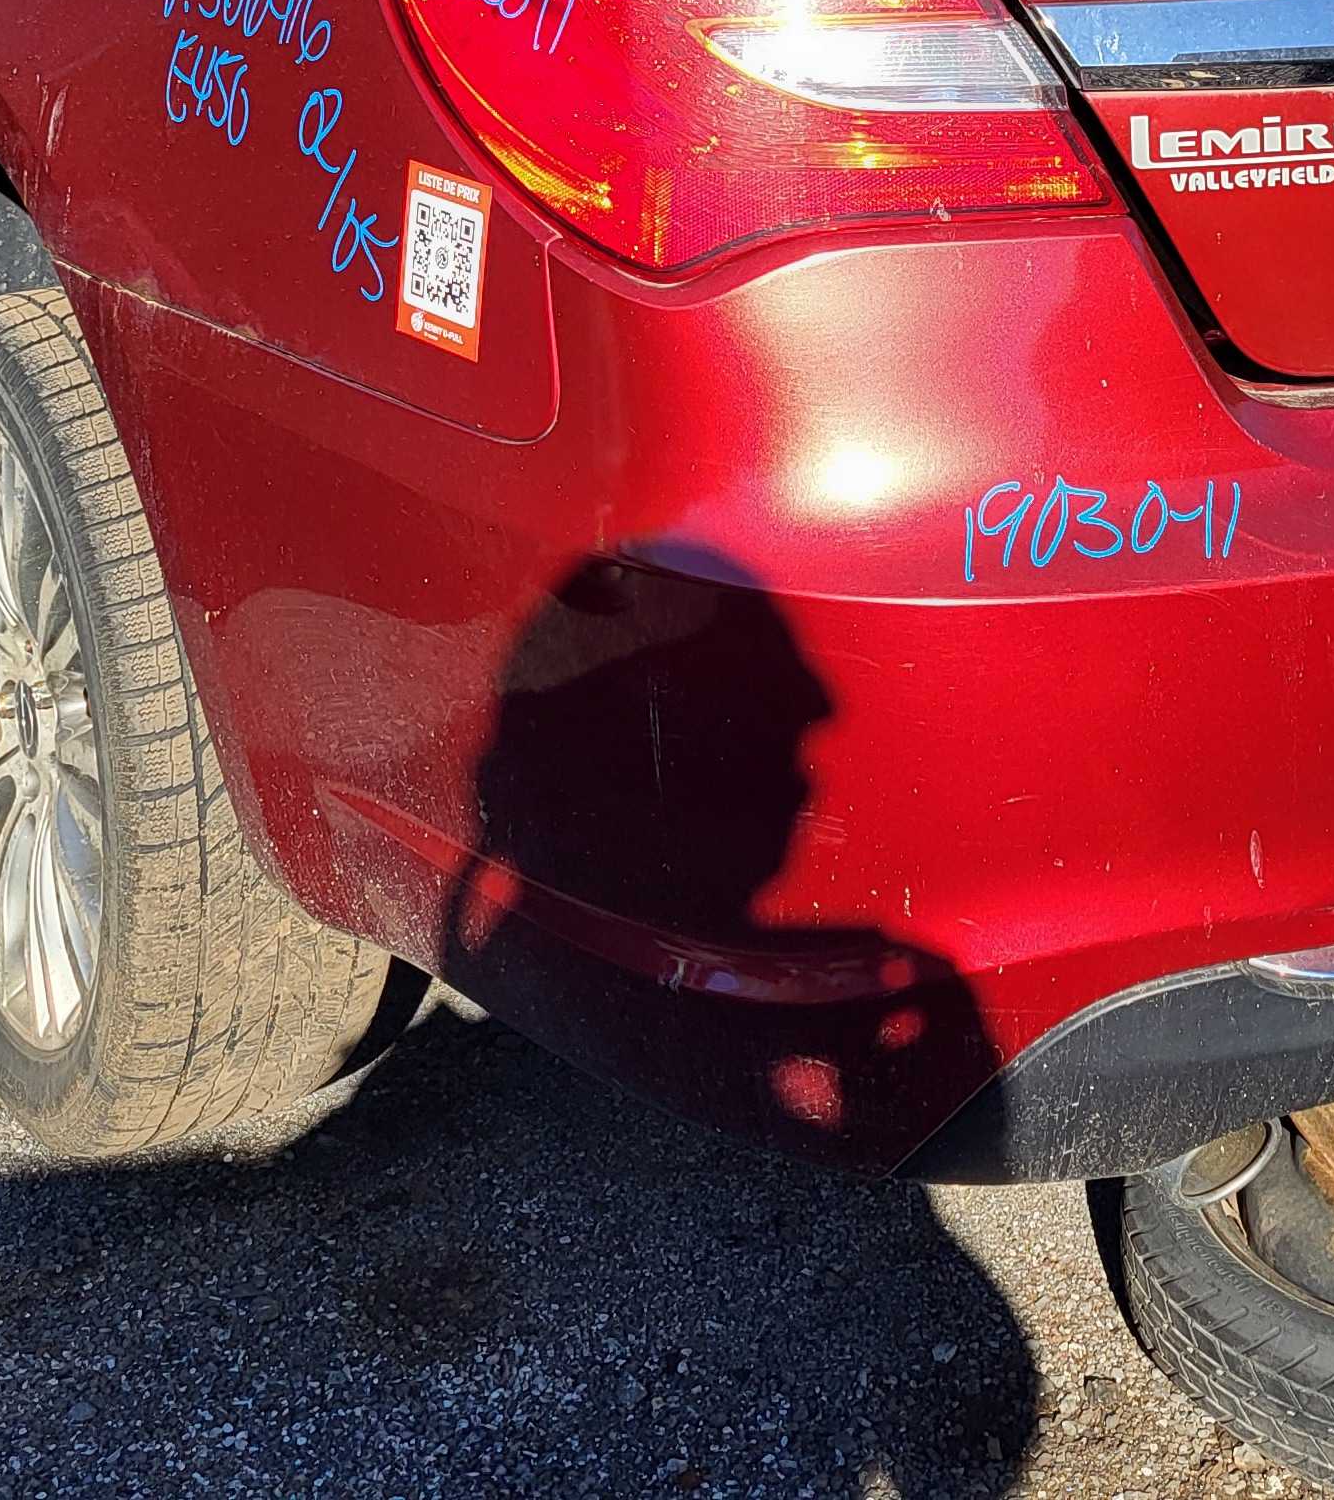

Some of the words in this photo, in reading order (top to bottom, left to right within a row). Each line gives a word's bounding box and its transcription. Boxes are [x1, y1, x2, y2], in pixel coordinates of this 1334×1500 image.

[418, 170, 444, 191] LISTE
[443, 179, 457, 196] DE
[456, 183, 481, 204] PRIX
[964, 475, 1242, 582] 19030-11
